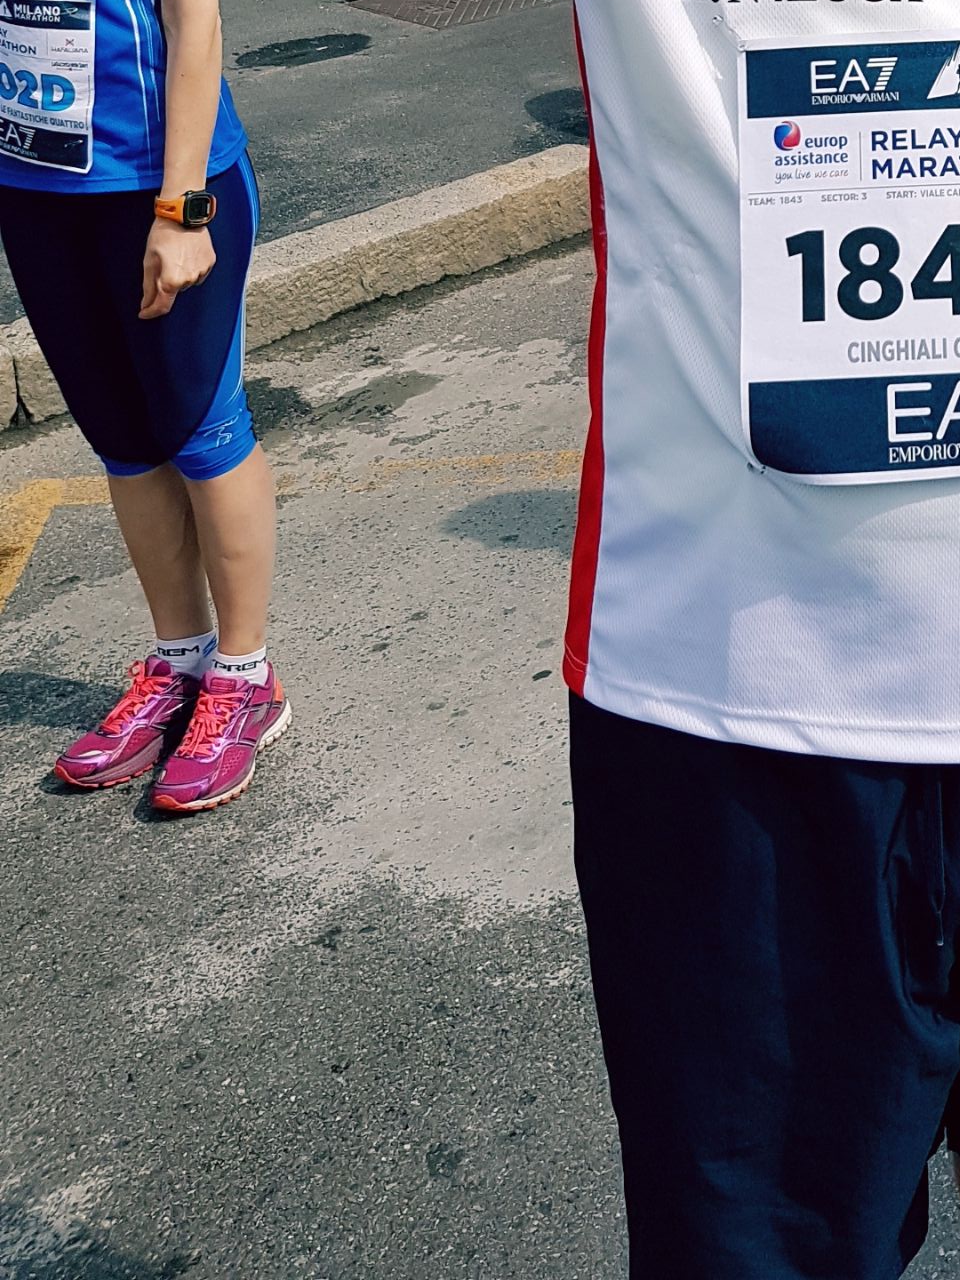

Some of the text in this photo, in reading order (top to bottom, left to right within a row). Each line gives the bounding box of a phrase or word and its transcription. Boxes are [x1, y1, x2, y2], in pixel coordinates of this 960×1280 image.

[13, 2, 61, 16] MILANO
[0, 40, 37, 55] ATHON
[810, 56, 898, 94] EA7
[811, 91, 900, 106] EMPORIO ARMANI
[49, 117, 85, 130] QUATTRO
[804, 135, 848, 150] europ
[774, 151, 849, 167] assistance
[774, 168, 849, 185] you live we care
[748, 198, 776, 207] TEAM:
[779, 195, 803, 205] 1843
[821, 193, 860, 203] SECTOR:
[860, 193, 868, 201] 3
[886, 190, 918, 200] START:
[919, 188, 946, 198] VIALE
[847, 339, 949, 364] CINGHIALI
[888, 442, 960, 464] EMPORIO
